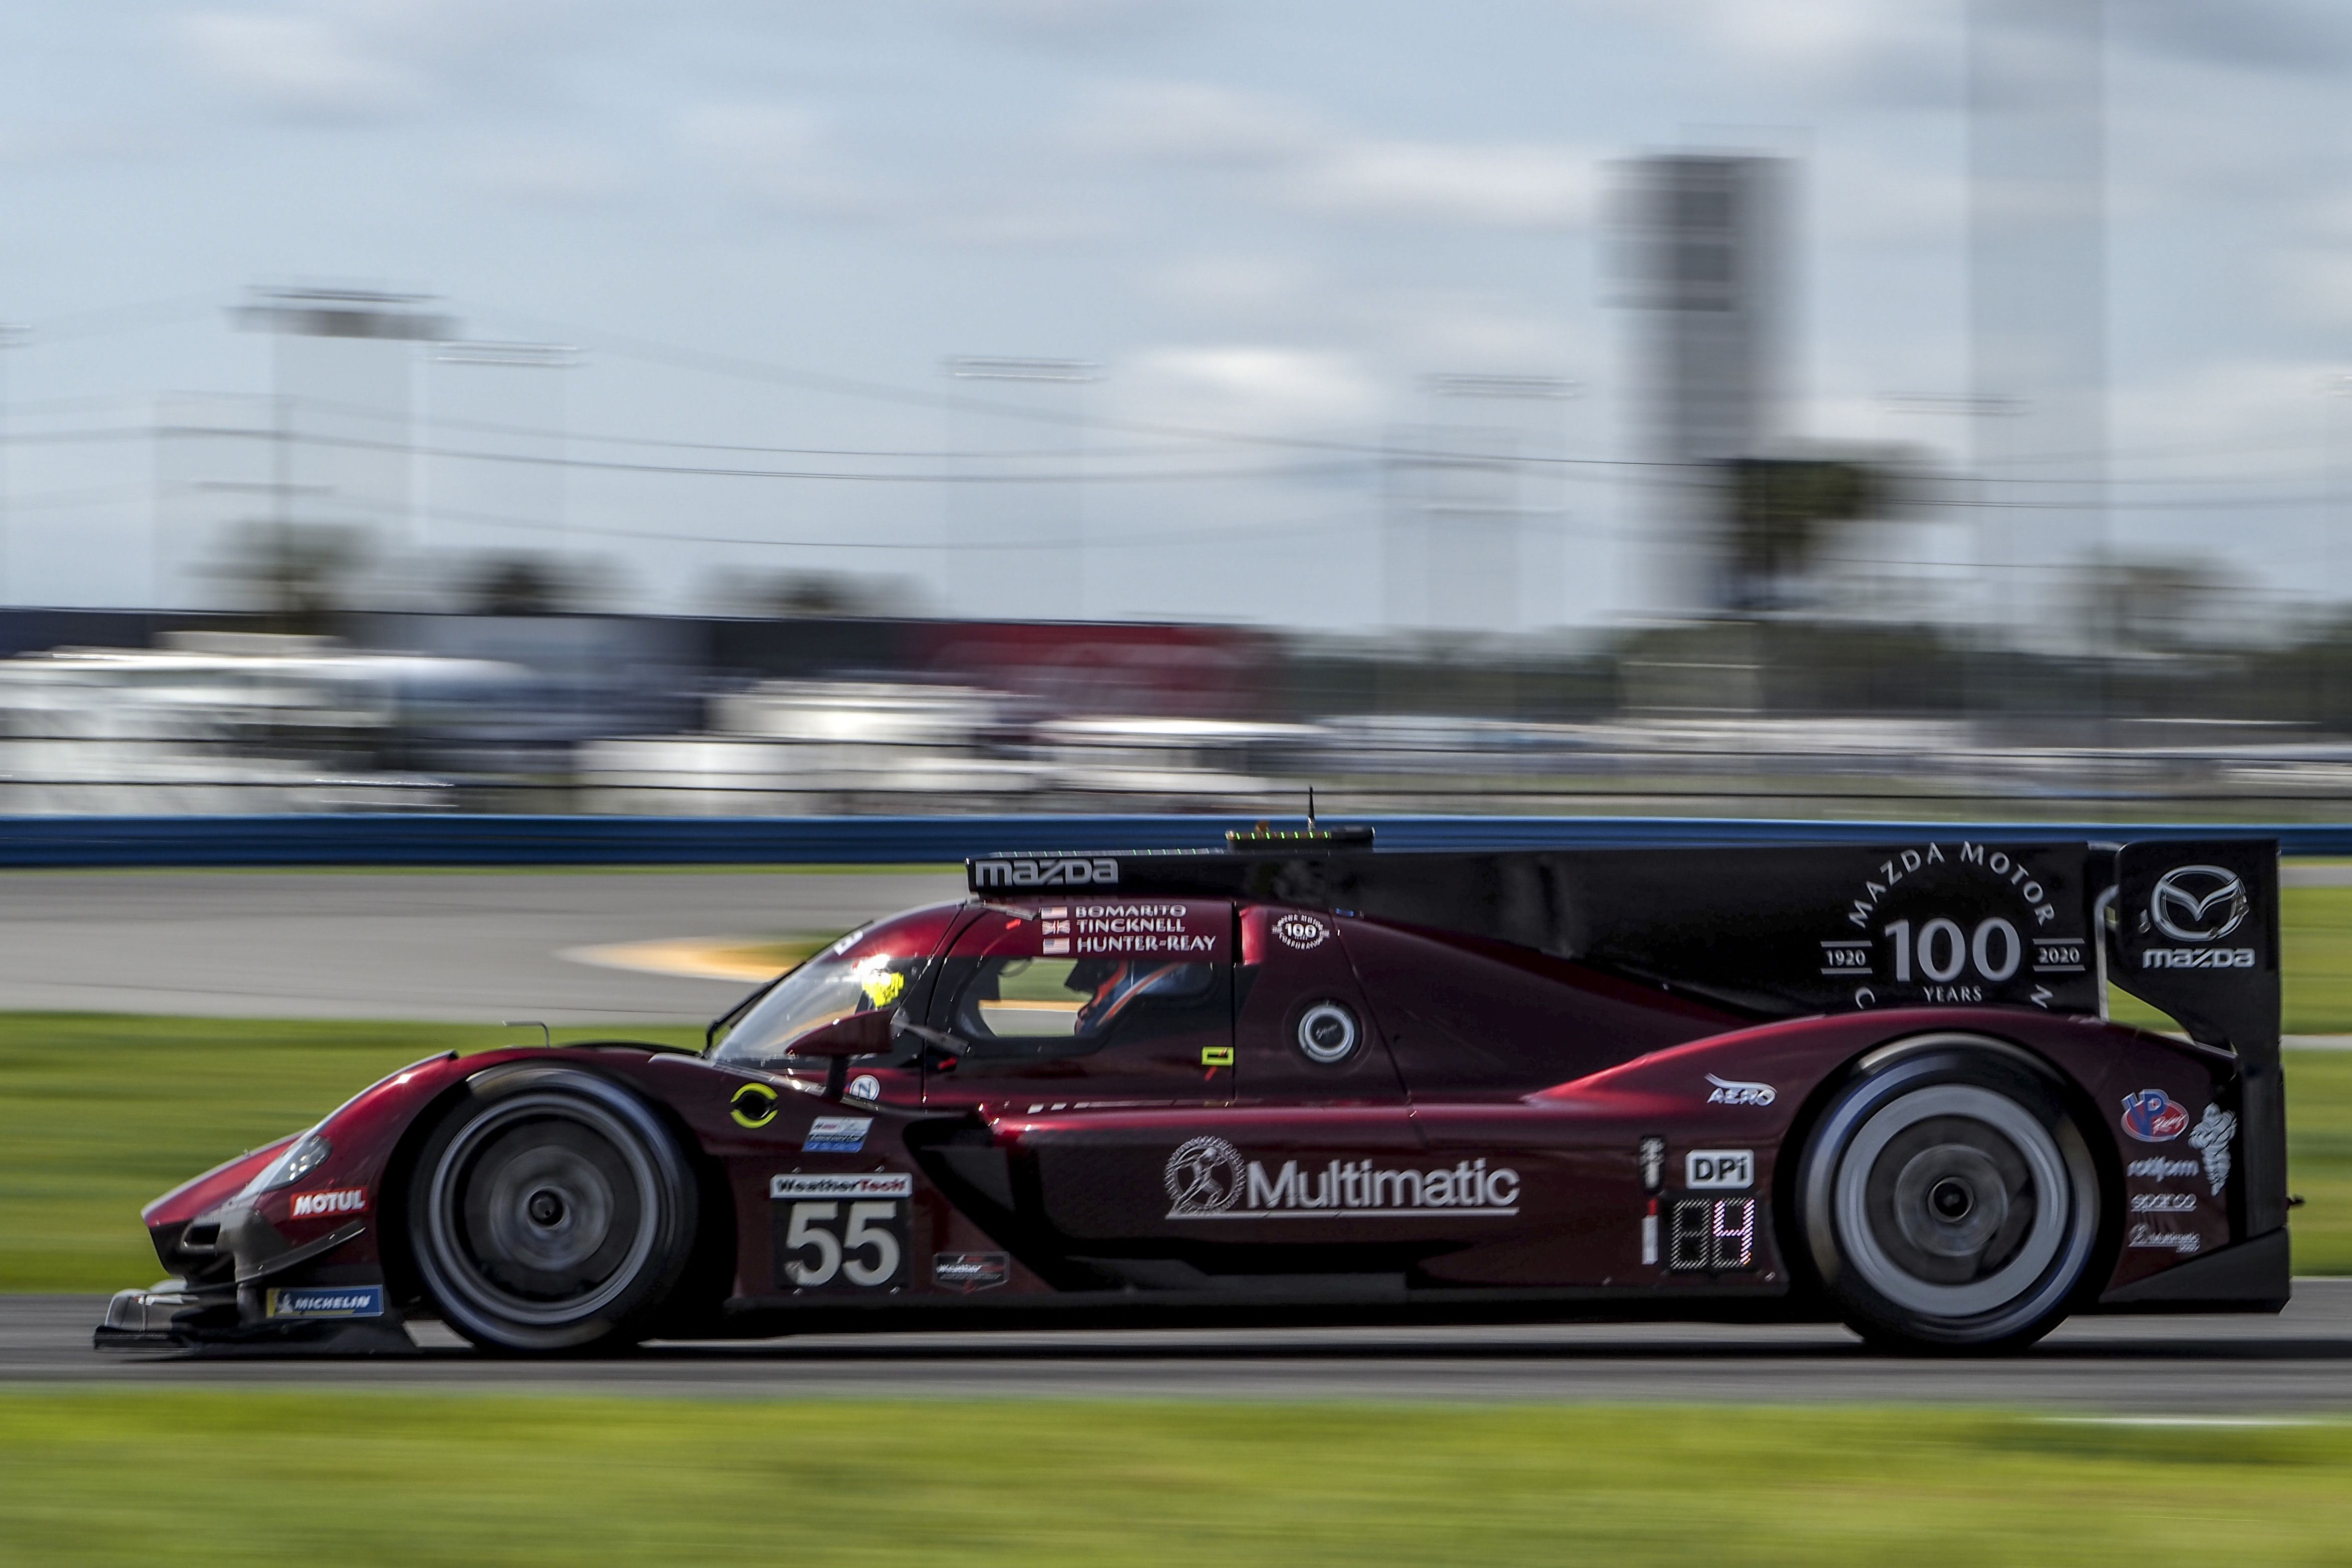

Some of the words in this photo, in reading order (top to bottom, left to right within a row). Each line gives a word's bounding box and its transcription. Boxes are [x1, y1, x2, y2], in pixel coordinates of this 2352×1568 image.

[1849, 842, 1945, 928] MAZDA
[1960, 841, 2054, 927] MOTOR
[1076, 904, 1186, 917] BOMARITO
[1077, 918, 1186, 933] TINCKNELL
[1285, 922, 1317, 938] 100
[1077, 935, 1216, 953] HUNTER-REAY
[1885, 917, 2021, 982] 100
[1826, 950, 1866, 966] 1920
[2038, 947, 2080, 964] 2020
[1922, 986, 1982, 1002] YEARS
[1707, 1088, 1777, 1106] AERO
[1695, 1157, 1748, 1182] DPi
[777, 1178, 907, 1192] WeatherTech
[1246, 1158, 1521, 1208] Multimatic
[293, 1189, 366, 1216] MOTUL
[784, 1201, 901, 1287] 55
[295, 1295, 372, 1311] MICHELIN
